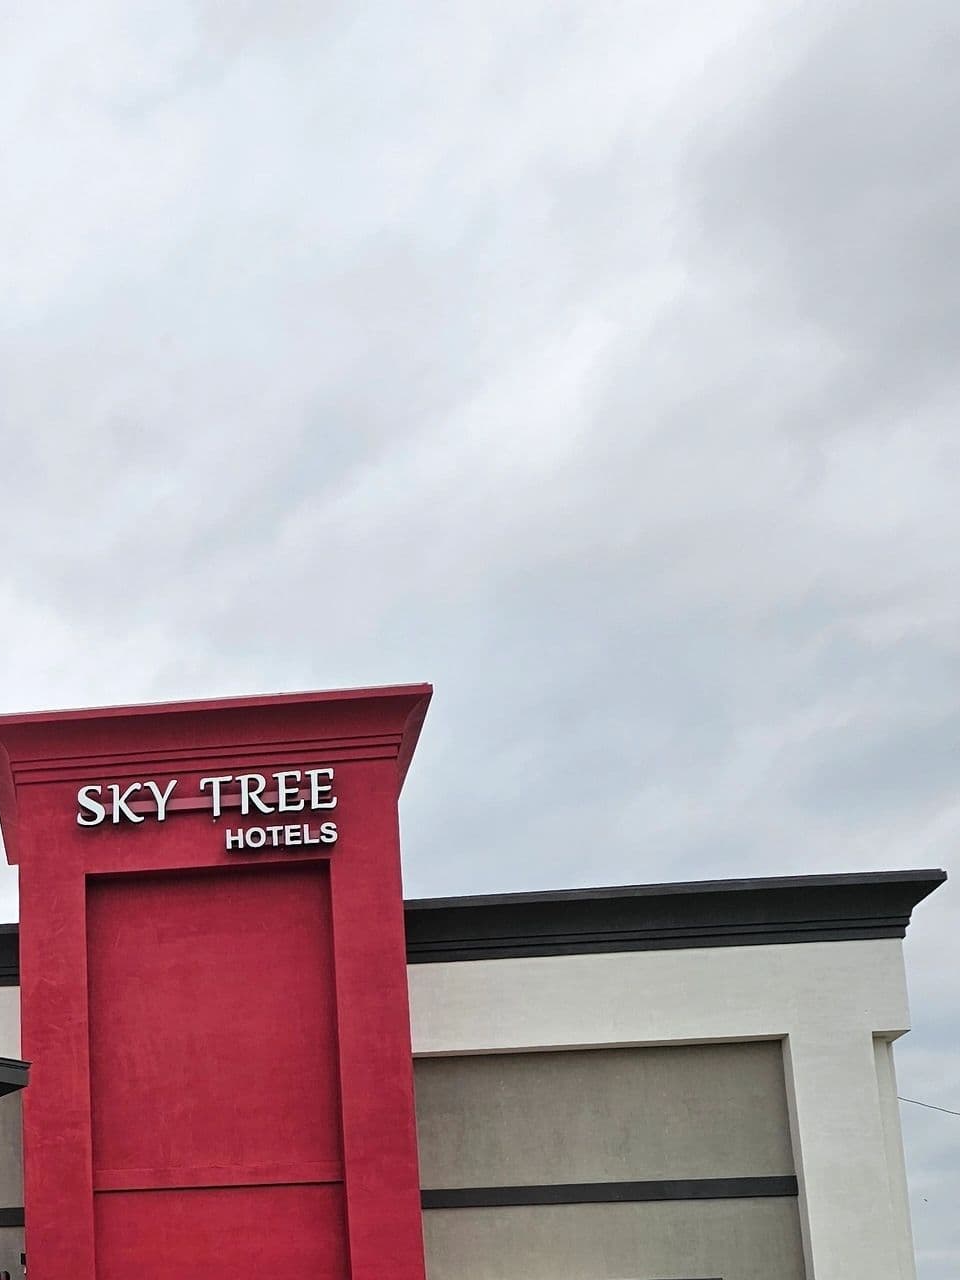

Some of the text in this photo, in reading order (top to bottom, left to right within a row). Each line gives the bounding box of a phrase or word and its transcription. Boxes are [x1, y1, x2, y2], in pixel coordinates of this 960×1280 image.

[76, 768, 337, 826] SKY TREE
[225, 822, 338, 849] HOTELS
